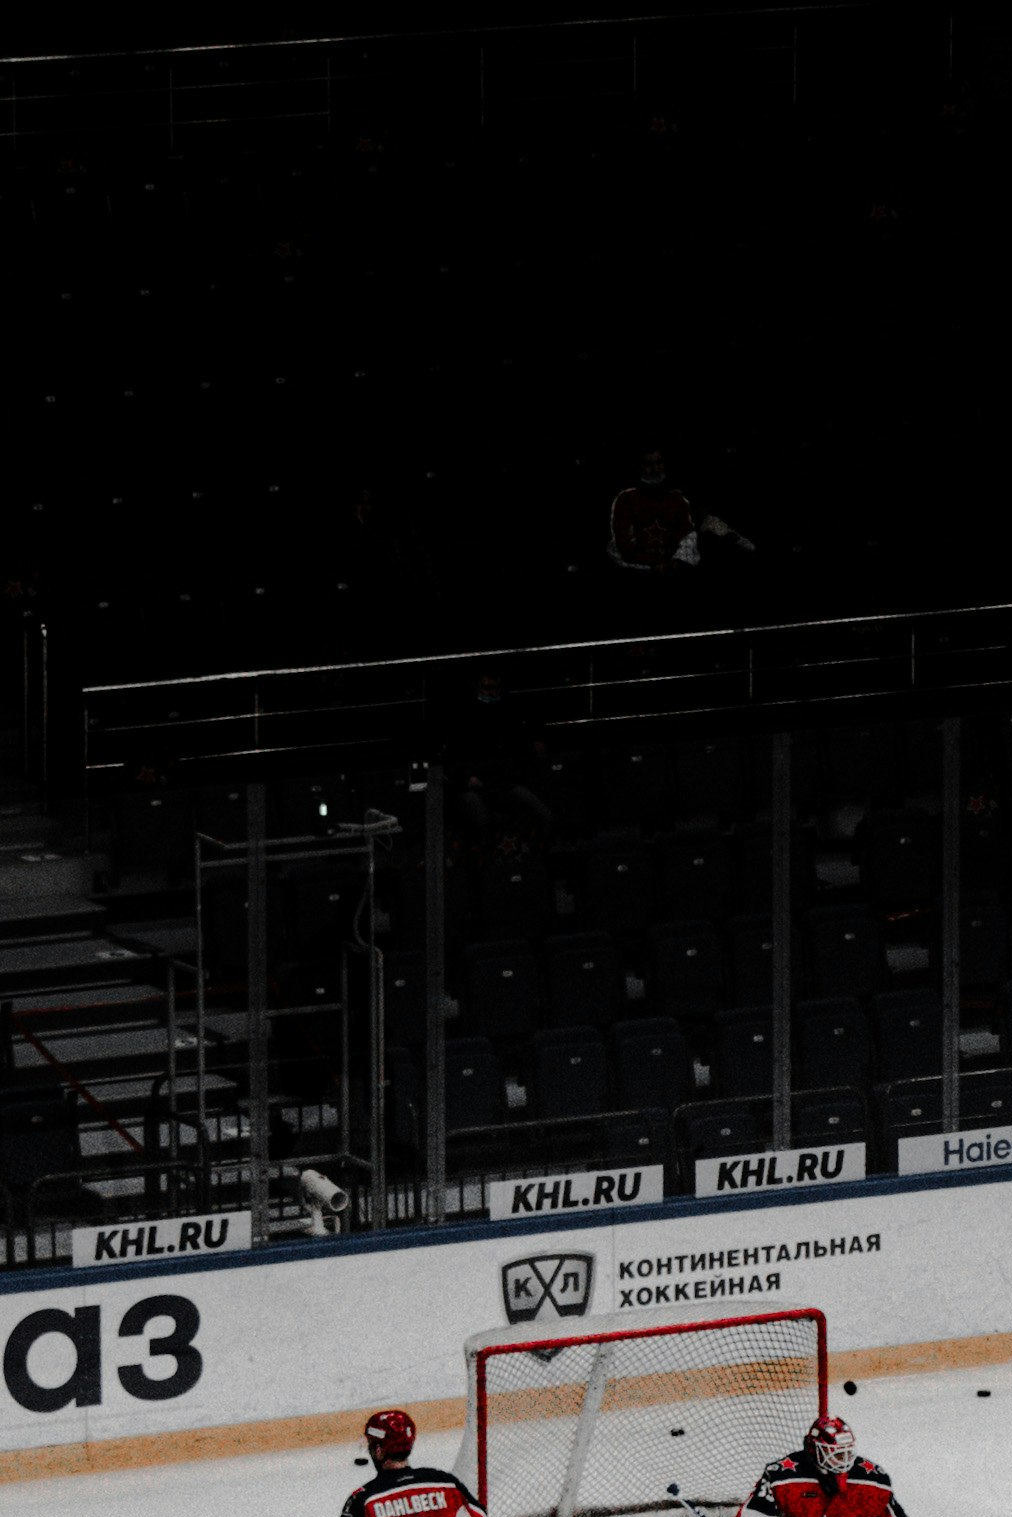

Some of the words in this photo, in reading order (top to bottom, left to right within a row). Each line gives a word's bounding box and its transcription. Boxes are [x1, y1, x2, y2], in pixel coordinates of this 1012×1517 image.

[717, 1150, 845, 1190] KHL.RU
[510, 1172, 642, 1213] KHL.RU
[94, 1219, 229, 1260] KHL.RU
[619, 1234, 881, 1280] КОНТИНЕНТАЛЬНАЯ
[620, 1272, 781, 1308] ХОККЕЙНАЯ
